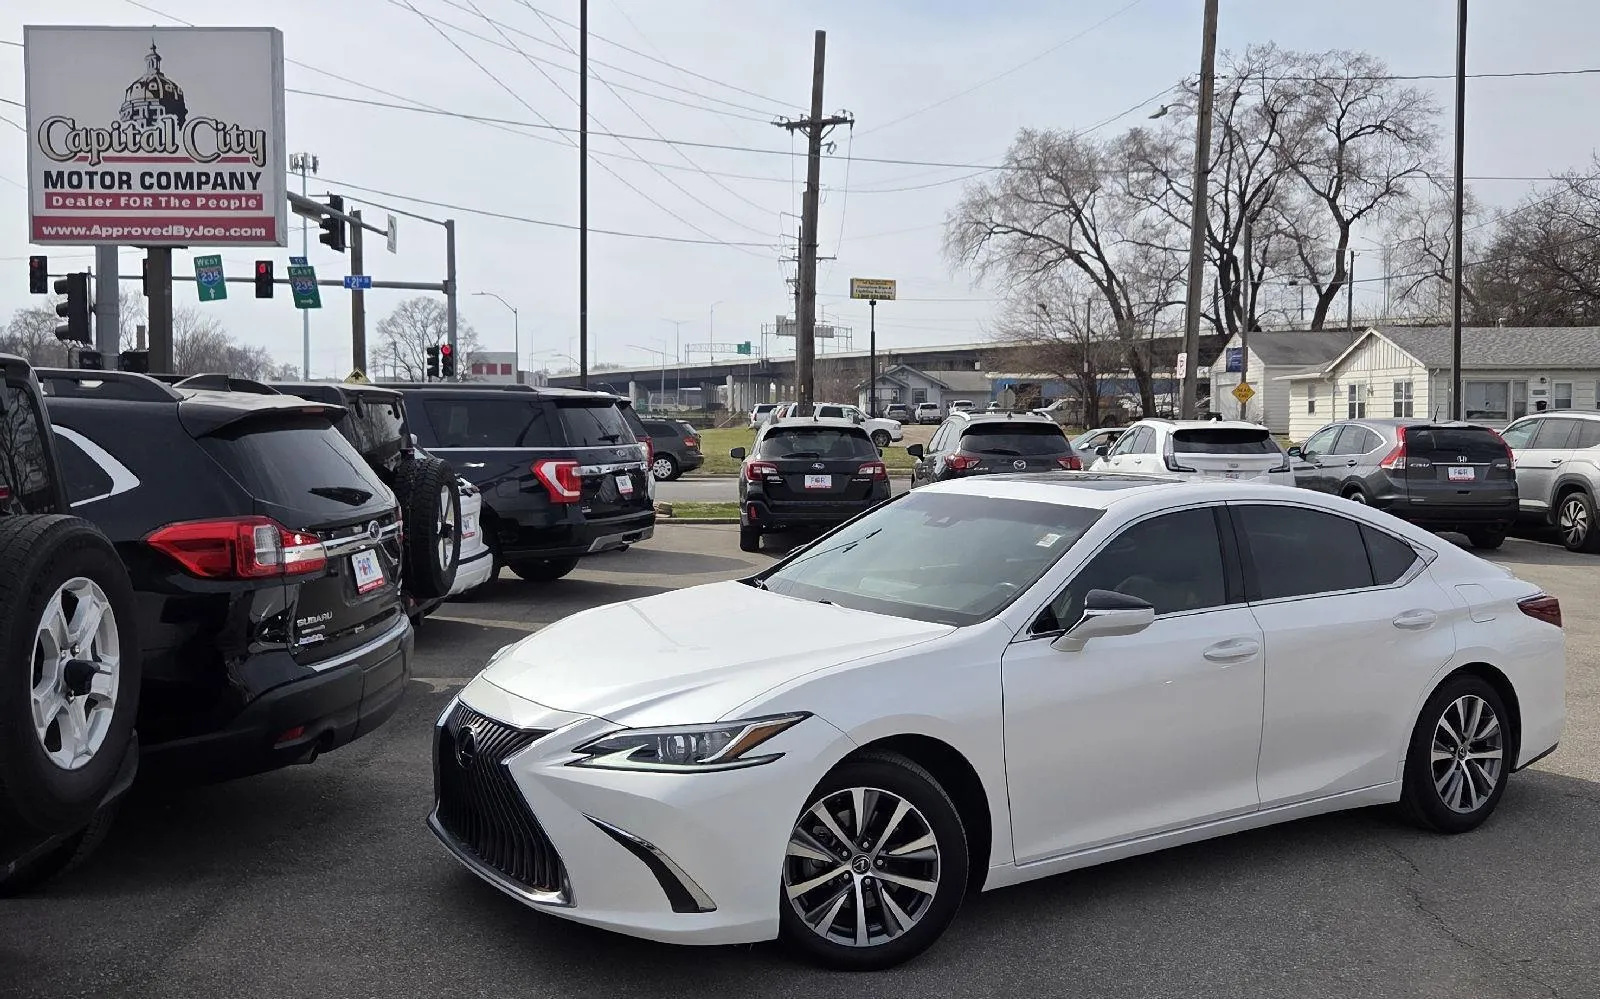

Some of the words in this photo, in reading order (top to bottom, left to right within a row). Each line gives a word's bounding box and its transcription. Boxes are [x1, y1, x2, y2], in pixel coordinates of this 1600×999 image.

[38, 115, 179, 167] Capital
[183, 117, 267, 167] City
[43, 170, 132, 190] MOTOR
[139, 171, 262, 191] COMPANY
[52, 196, 113, 207] Dealer
[120, 196, 154, 207] FOR
[159, 196, 191, 208] The
[196, 196, 257, 210] People
[42, 224, 266, 239] www.ApprovedByJoe.com
[200, 271, 220, 281] 235
[295, 282, 314, 291] 235
[296, 611, 333, 627] SUBARU
